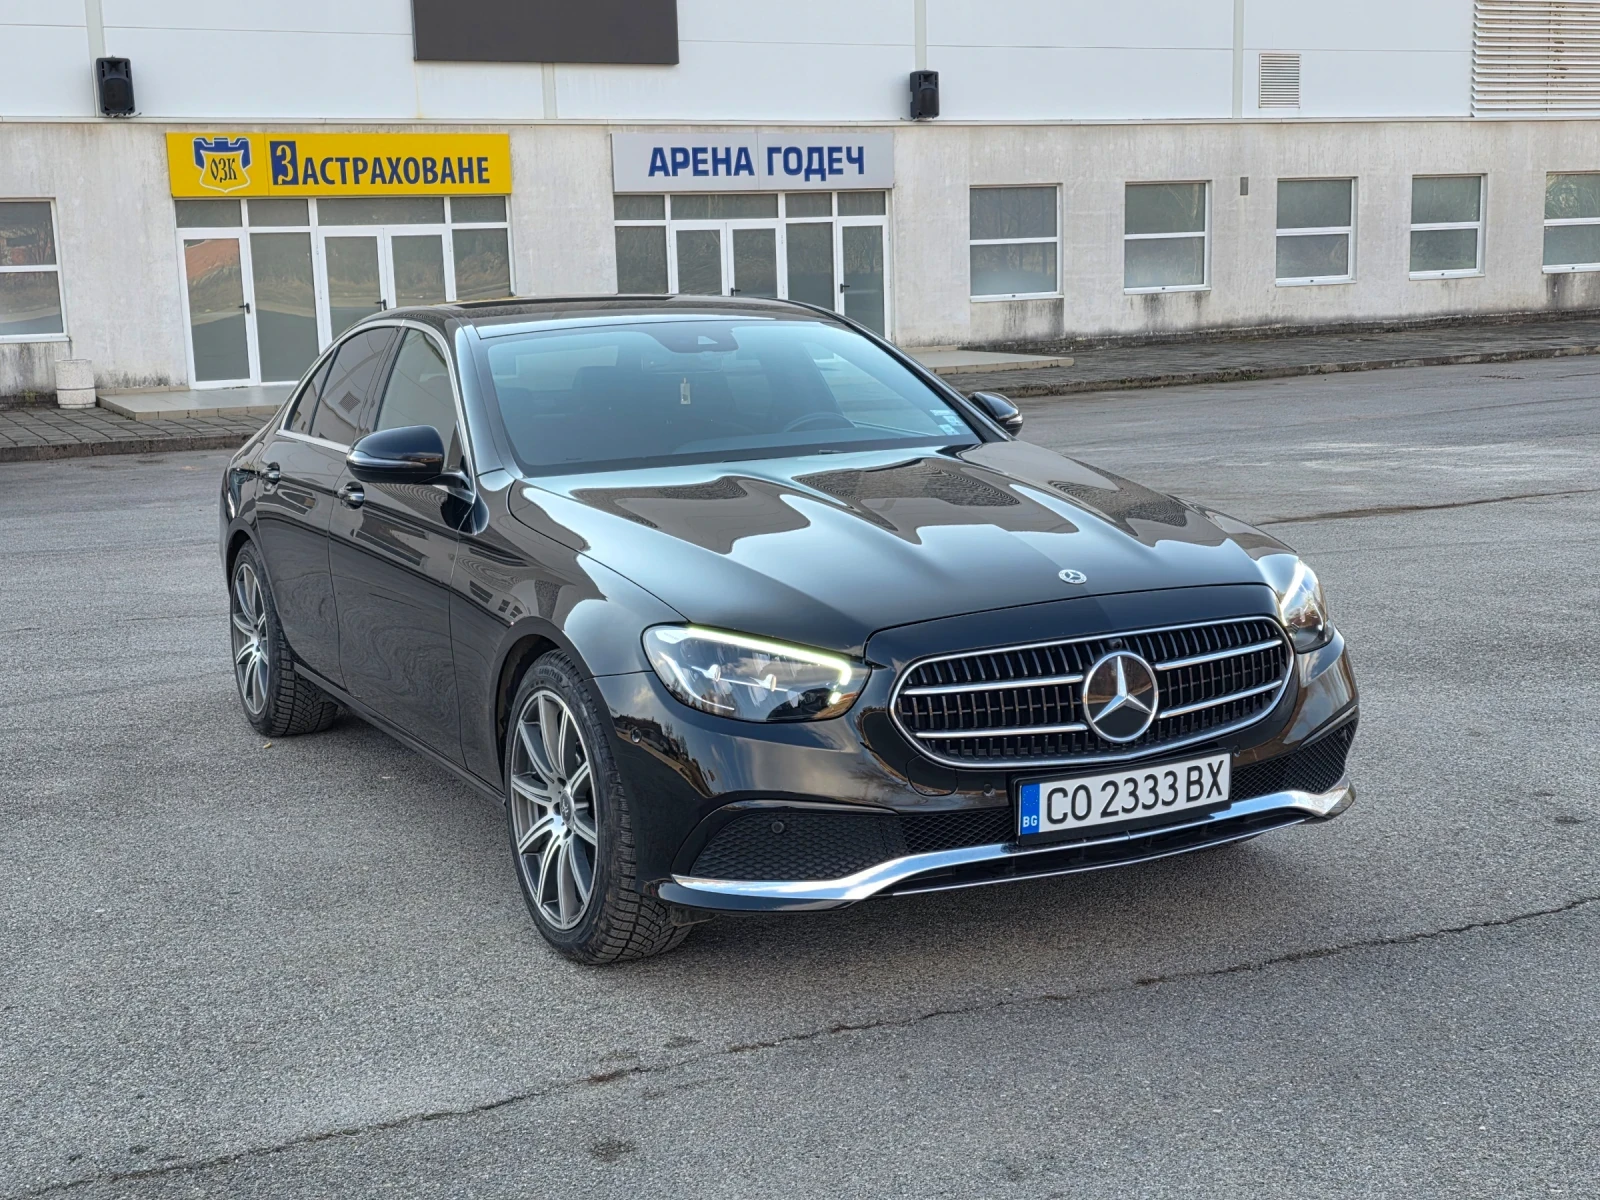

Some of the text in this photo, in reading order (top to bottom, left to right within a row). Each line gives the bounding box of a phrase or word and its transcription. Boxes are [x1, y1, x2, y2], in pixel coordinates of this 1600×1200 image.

[210, 158, 238, 183] ОЗК
[271, 142, 490, 185] ЗАСТРАХОВАНЕ
[648, 146, 865, 182] АРЕНА ГОДЕЧ
[1100, 770, 1179, 818] 2333
[1023, 815, 1038, 828] BG
